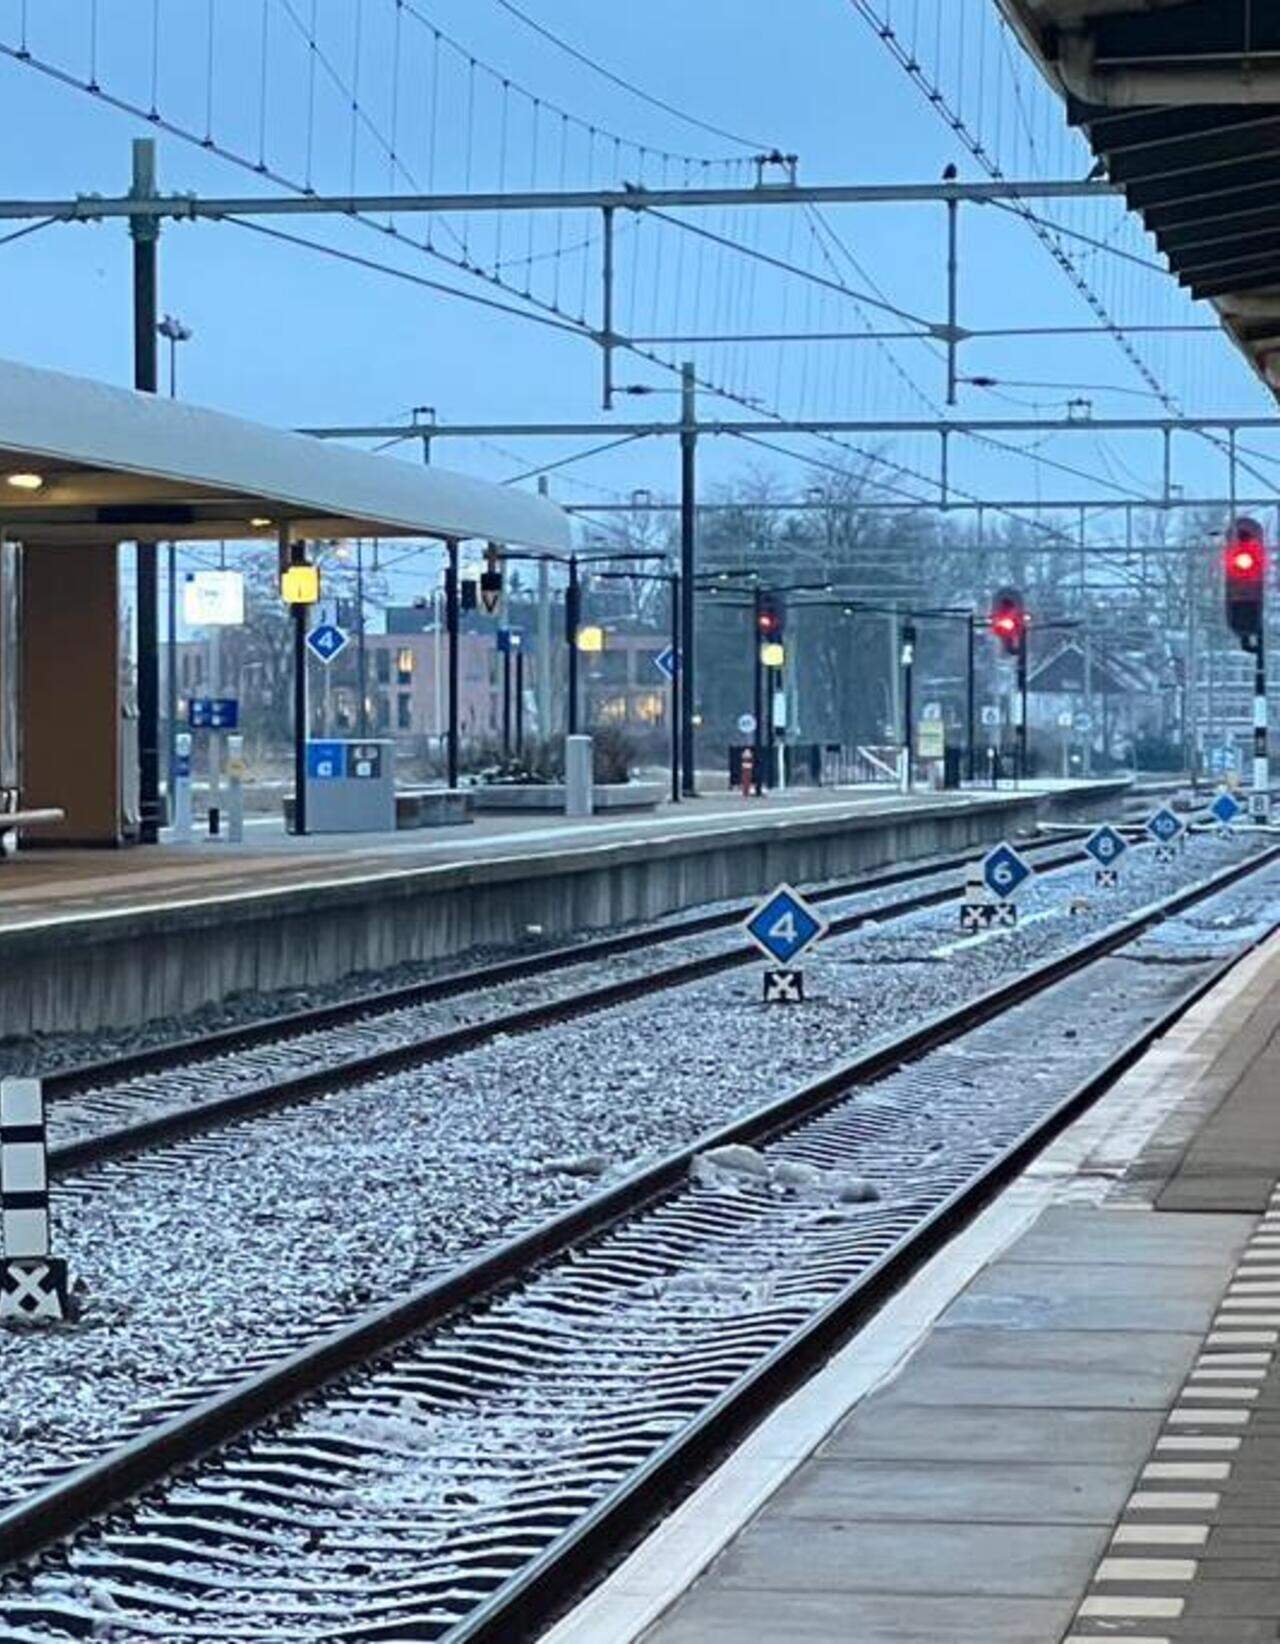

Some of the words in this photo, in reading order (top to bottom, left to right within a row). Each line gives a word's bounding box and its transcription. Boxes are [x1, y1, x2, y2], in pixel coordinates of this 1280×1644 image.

[317, 632, 333, 650] 4
[993, 861, 1013, 884] 6
[768, 911, 798, 943] 4
